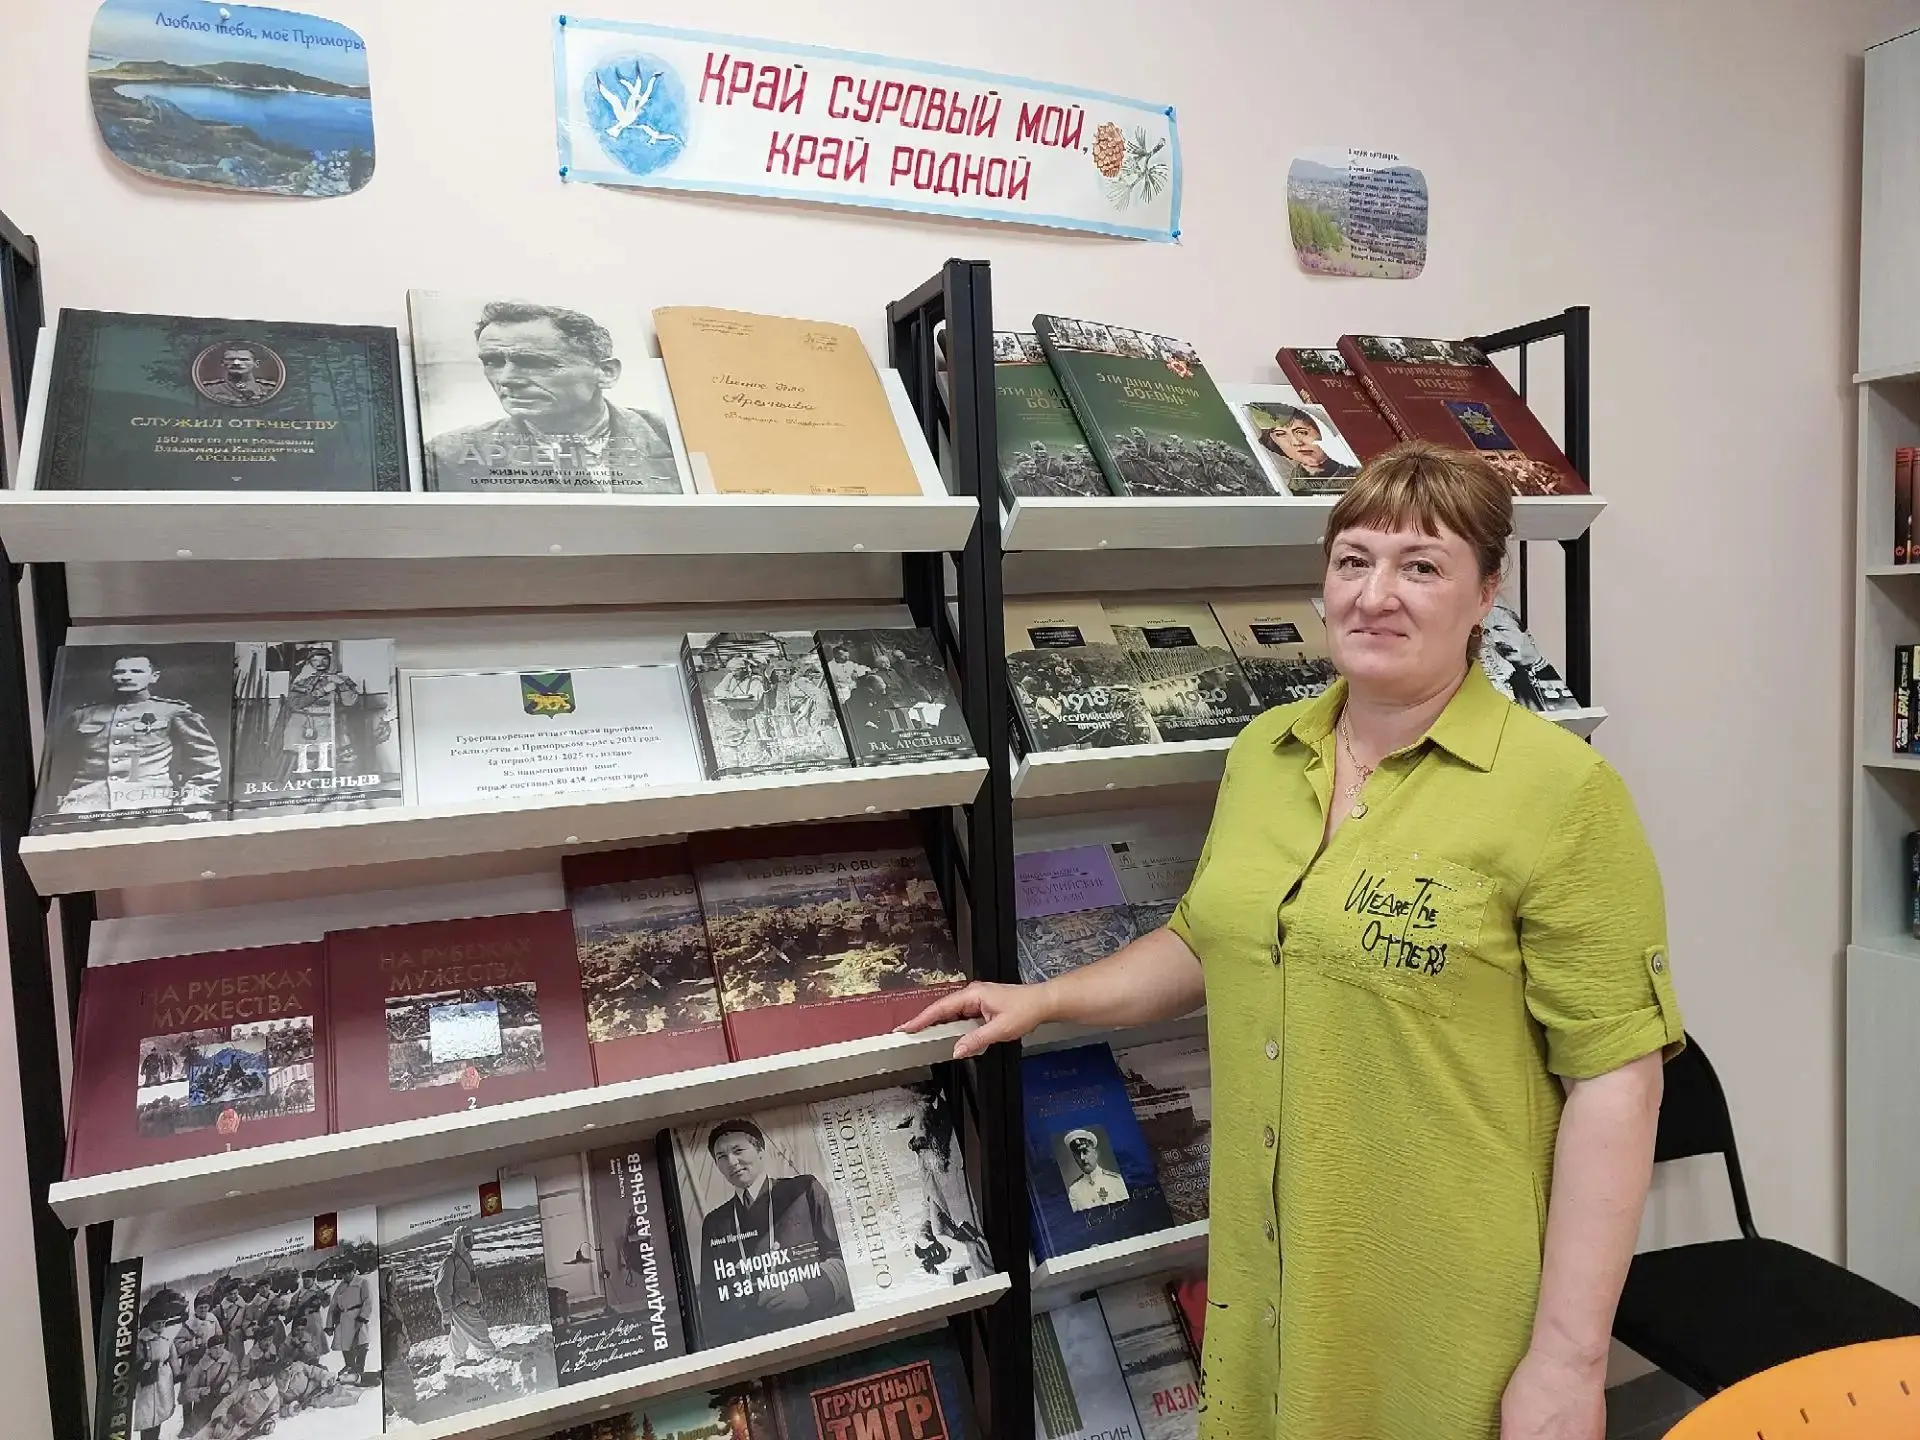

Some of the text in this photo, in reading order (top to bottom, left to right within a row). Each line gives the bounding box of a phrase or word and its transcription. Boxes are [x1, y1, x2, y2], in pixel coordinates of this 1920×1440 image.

[155, 12, 210, 32] Люблю
[215, 21, 257, 39] тебя,
[262, 29, 289, 41] моё
[1096, 373, 1122, 384] ЭТИ
[1125, 376, 1151, 389] ДНИ
[1167, 384, 1200, 398] НОЧИ
[1414, 378, 1471, 391] ПОБЕД
[131, 417, 338, 430] СЛУЖИЛ ОТЕЧЕСТВУ
[157, 436, 178, 444] 150
[194, 454, 277, 462] АРСЕНЬЕВА
[1059, 688, 1110, 713] 1918
[1175, 687, 1228, 706] 1920
[1057, 711, 1125, 722] УССУРИЙСКИЙ
[522, 740, 584, 752] Приморском
[869, 736, 963, 751] В.К. АРСЕНЬЕВ
[293, 743, 333, 773] II
[244, 774, 381, 795] В.К. АРСЕНЬЕВ
[829, 862, 847, 873] ЗА
[850, 857, 916, 872] СВООДУ
[636, 885, 695, 900] БОРЬБ
[379, 938, 533, 972] НА РУБЕЖАХ
[188, 968, 312, 1000] РУБЕЖАХ
[390, 963, 526, 991] МУЖЕСТВА
[152, 994, 302, 1029] МУЖЕСТВА
[467, 1097, 477, 1109] 2
[1174, 1177, 1210, 1194] СОХР
[835, 1109, 893, 1289] ОЛЕНЬ-ЦВЕТОК
[628, 1152, 669, 1351] ВЛАДИМИР АРСЕНЬЕВ
[710, 1237, 726, 1247] Анна
[713, 1258, 736, 1280] На
[740, 1248, 791, 1275] морях
[718, 1262, 821, 1302] и за морями
[115, 1271, 137, 1357] ГЕРОЯМИ
[112, 1360, 131, 1402] БОЮ
[822, 1369, 928, 1418] ГРУСТНЫЙ
[1153, 1381, 1201, 1416] РАЗЛ
[826, 1395, 932, 1440] ТИГР
